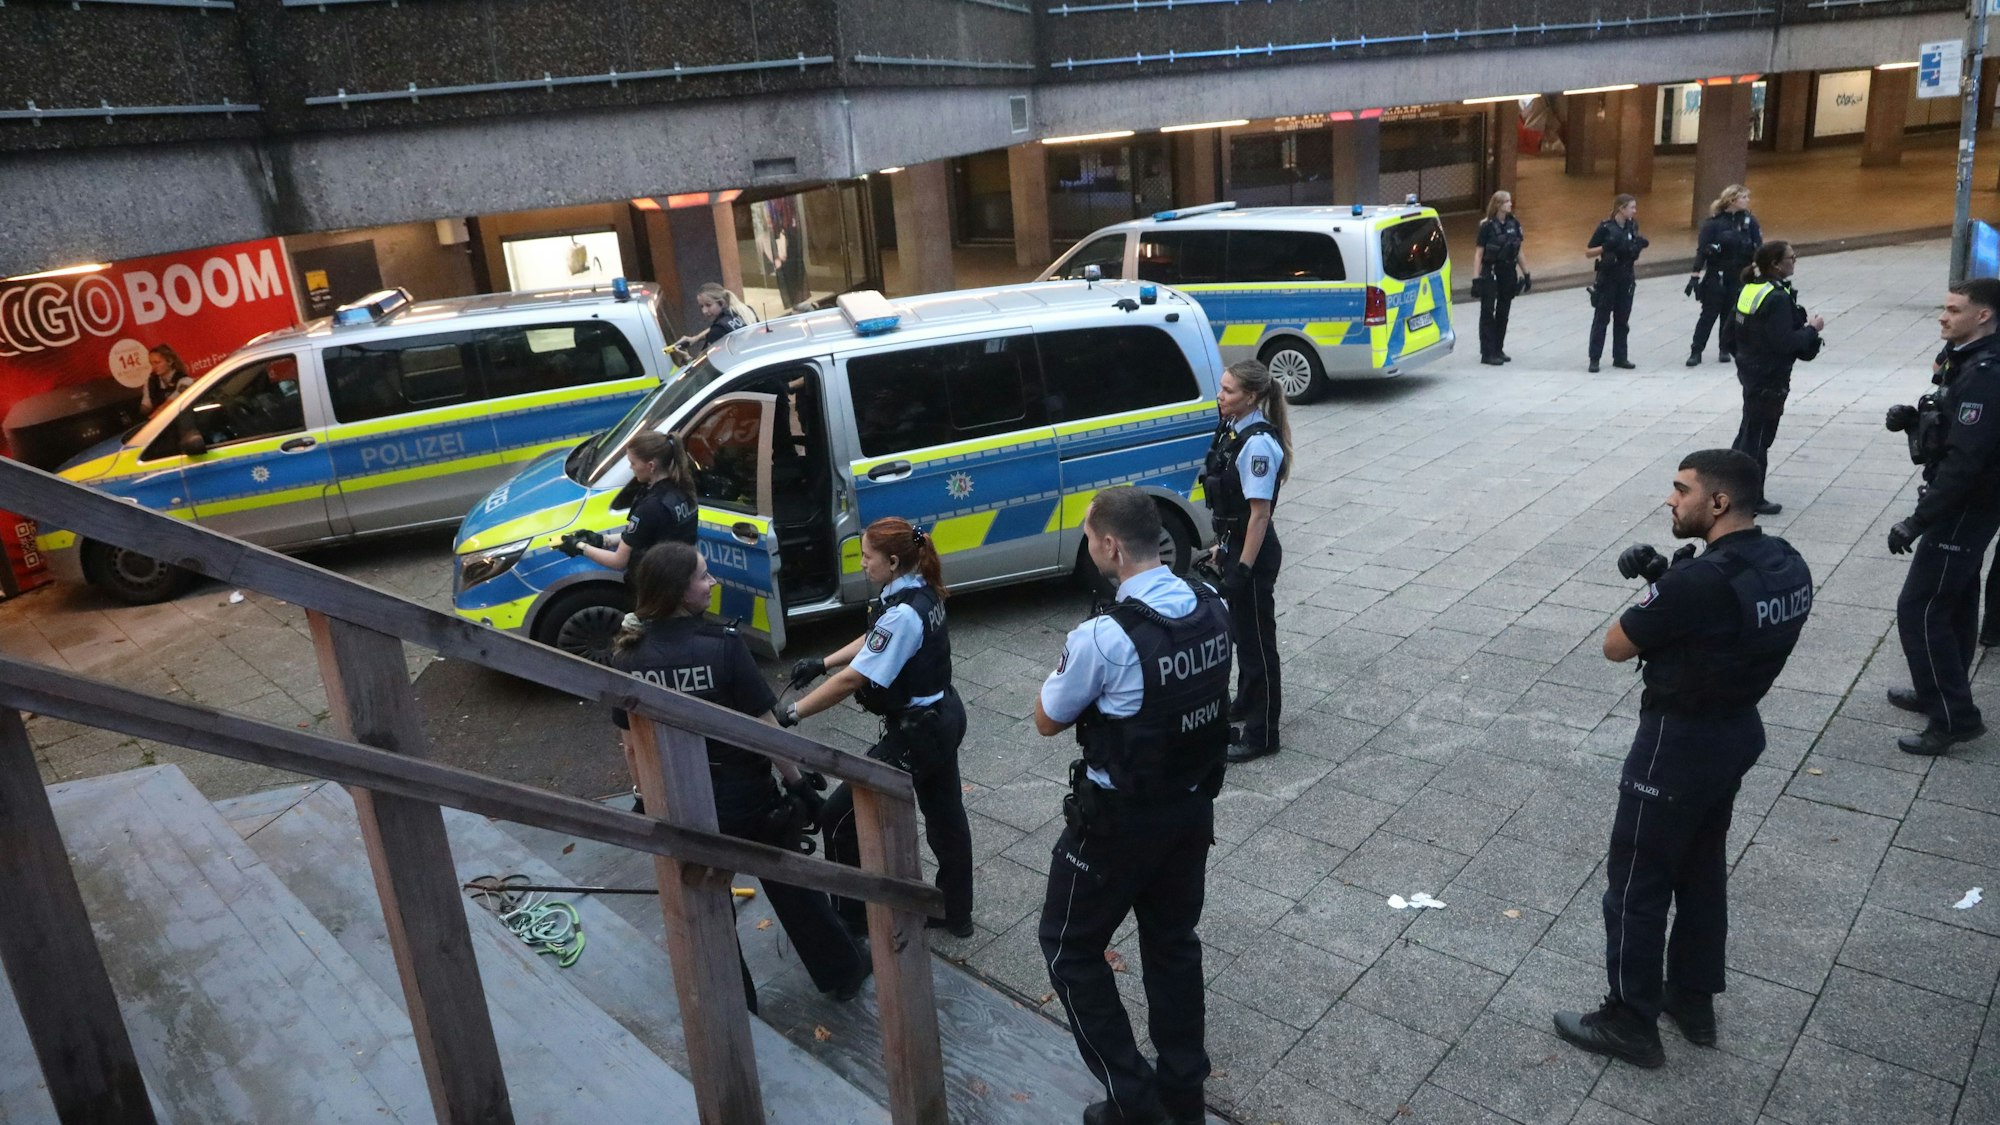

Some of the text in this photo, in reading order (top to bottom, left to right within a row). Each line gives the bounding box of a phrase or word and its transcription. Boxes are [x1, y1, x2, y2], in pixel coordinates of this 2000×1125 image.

[123, 249, 284, 325] BOOM
[360, 431, 465, 469] POLIZEI
[674, 502, 692, 522] POL
[697, 539, 748, 571] OLIZEI
[1756, 584, 1812, 629] POLIZEI
[1158, 631, 1230, 686] POLIZEI
[1181, 698, 1220, 733] NRW
[1633, 781, 1659, 797] POLIZEI
